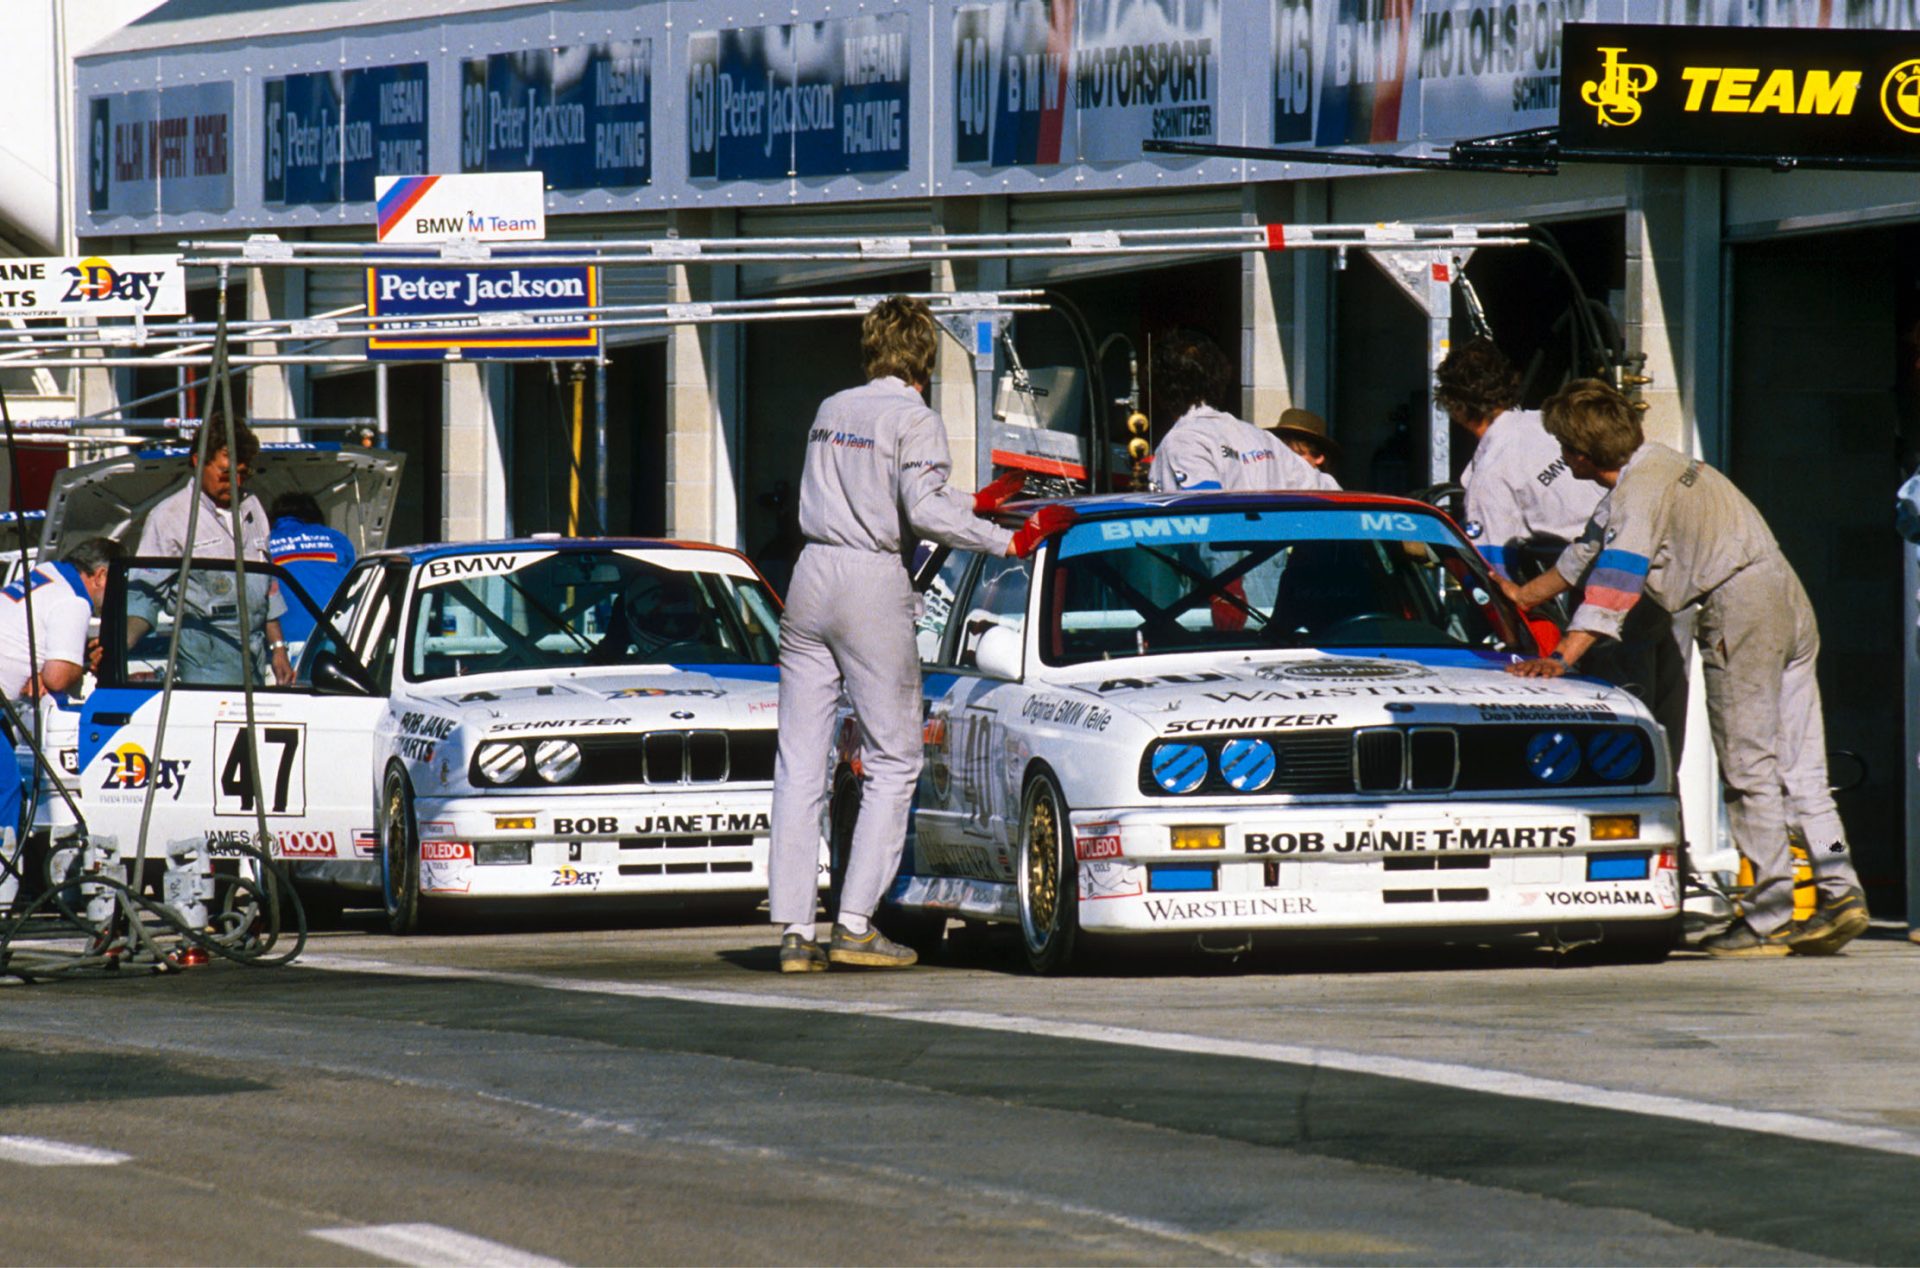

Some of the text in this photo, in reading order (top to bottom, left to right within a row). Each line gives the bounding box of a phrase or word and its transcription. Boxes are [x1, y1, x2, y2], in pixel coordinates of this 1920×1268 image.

[844, 32, 902, 86] NISSAN
[1336, 18, 1400, 86] BMW
[596, 58, 645, 106] NISSAN
[960, 37, 986, 135] 40
[1008, 53, 1062, 112] BMW
[1076, 38, 1212, 109] MOTORSPORT
[1681, 67, 1862, 115] TEAM
[380, 80, 423, 126] NISSAN
[691, 62, 714, 153] 60
[719, 70, 834, 157] Peter Jackson
[464, 83, 483, 168] 30
[489, 88, 586, 166] Peter Jackson
[843, 100, 900, 154] RACING
[1152, 105, 1212, 139] SCHNITZER
[95, 119, 104, 192] 9
[268, 101, 282, 182] 15
[287, 108, 372, 183] Peter Jackson
[379, 139, 423, 175] RACING
[596, 121, 645, 169] RACING
[416, 216, 536, 235] BMW M Team
[61, 266, 165, 311] 2Day
[380, 271, 585, 306] Peter Jackson
[31, 420, 73, 429] NISSAN
[845, 433, 875, 450] Team
[1537, 455, 1567, 488] BMW
[1100, 513, 1417, 541] BMW M3
[428, 556, 517, 578] BMW
[1022, 694, 1112, 732] Original BMW Teile
[1202, 685, 1564, 704] WARSTEINER
[401, 711, 457, 740] BOB JANE
[490, 717, 632, 733] SCHNITZER
[1164, 714, 1338, 734] SCHNITZER
[101, 751, 191, 801] 2Day
[221, 726, 299, 812] 47
[279, 831, 332, 852] 1000
[554, 817, 619, 835] BOB
[635, 815, 702, 833] JANE
[1244, 826, 1576, 853] BOB JANE T-MARTS
[423, 845, 464, 859] TOLEDO
[1079, 836, 1118, 857] TOLEDO
[551, 869, 602, 891] 2Day
[1545, 890, 1656, 906] YOKOHAMA
[1144, 897, 1318, 921] WARSTEINER
